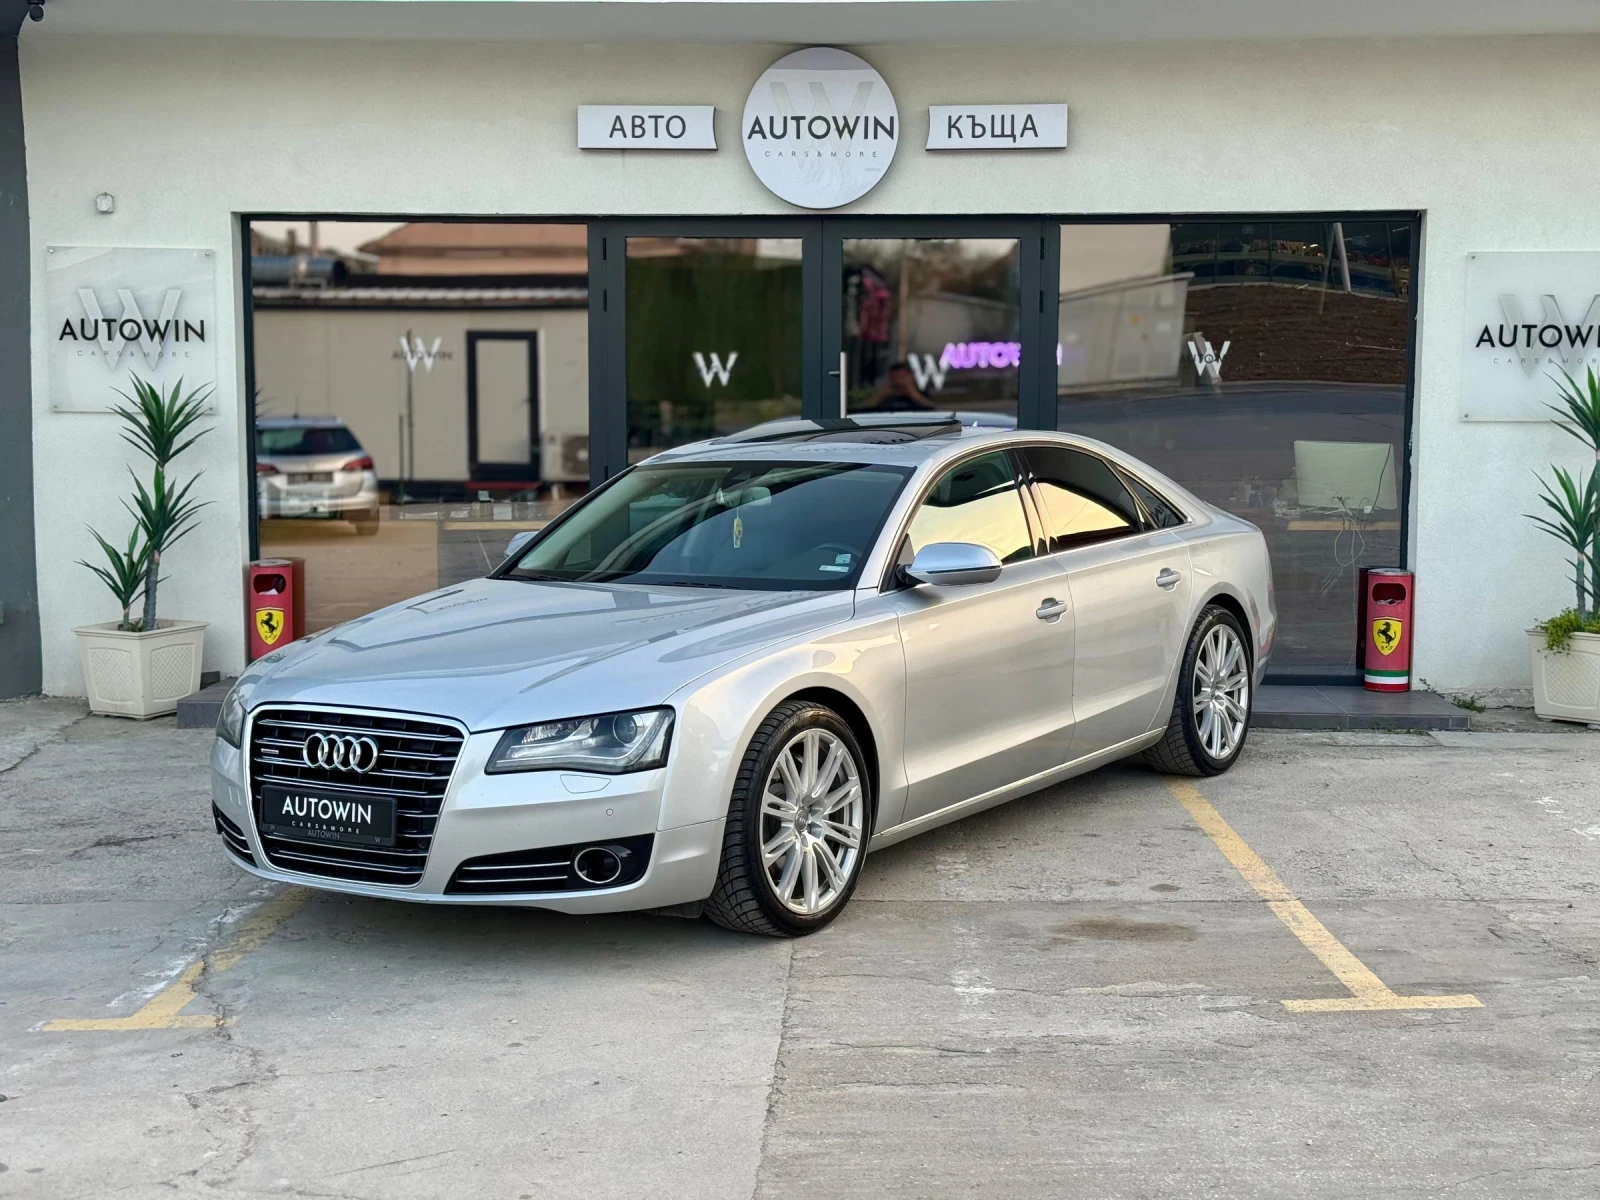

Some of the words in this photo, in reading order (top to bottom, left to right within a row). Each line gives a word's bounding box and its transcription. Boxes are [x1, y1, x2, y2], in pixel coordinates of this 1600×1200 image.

[609, 115, 686, 139] АВТО
[747, 115, 894, 140] AUTOWIN
[947, 114, 1039, 143] КЪЩА
[59, 318, 205, 343] AUTOWIN
[77, 350, 190, 358] CARS&MORE
[692, 351, 739, 388] W
[282, 795, 372, 825] AUTOWIN
[291, 820, 360, 834] CARS&MORE
[307, 829, 340, 840] AUTOWIN
